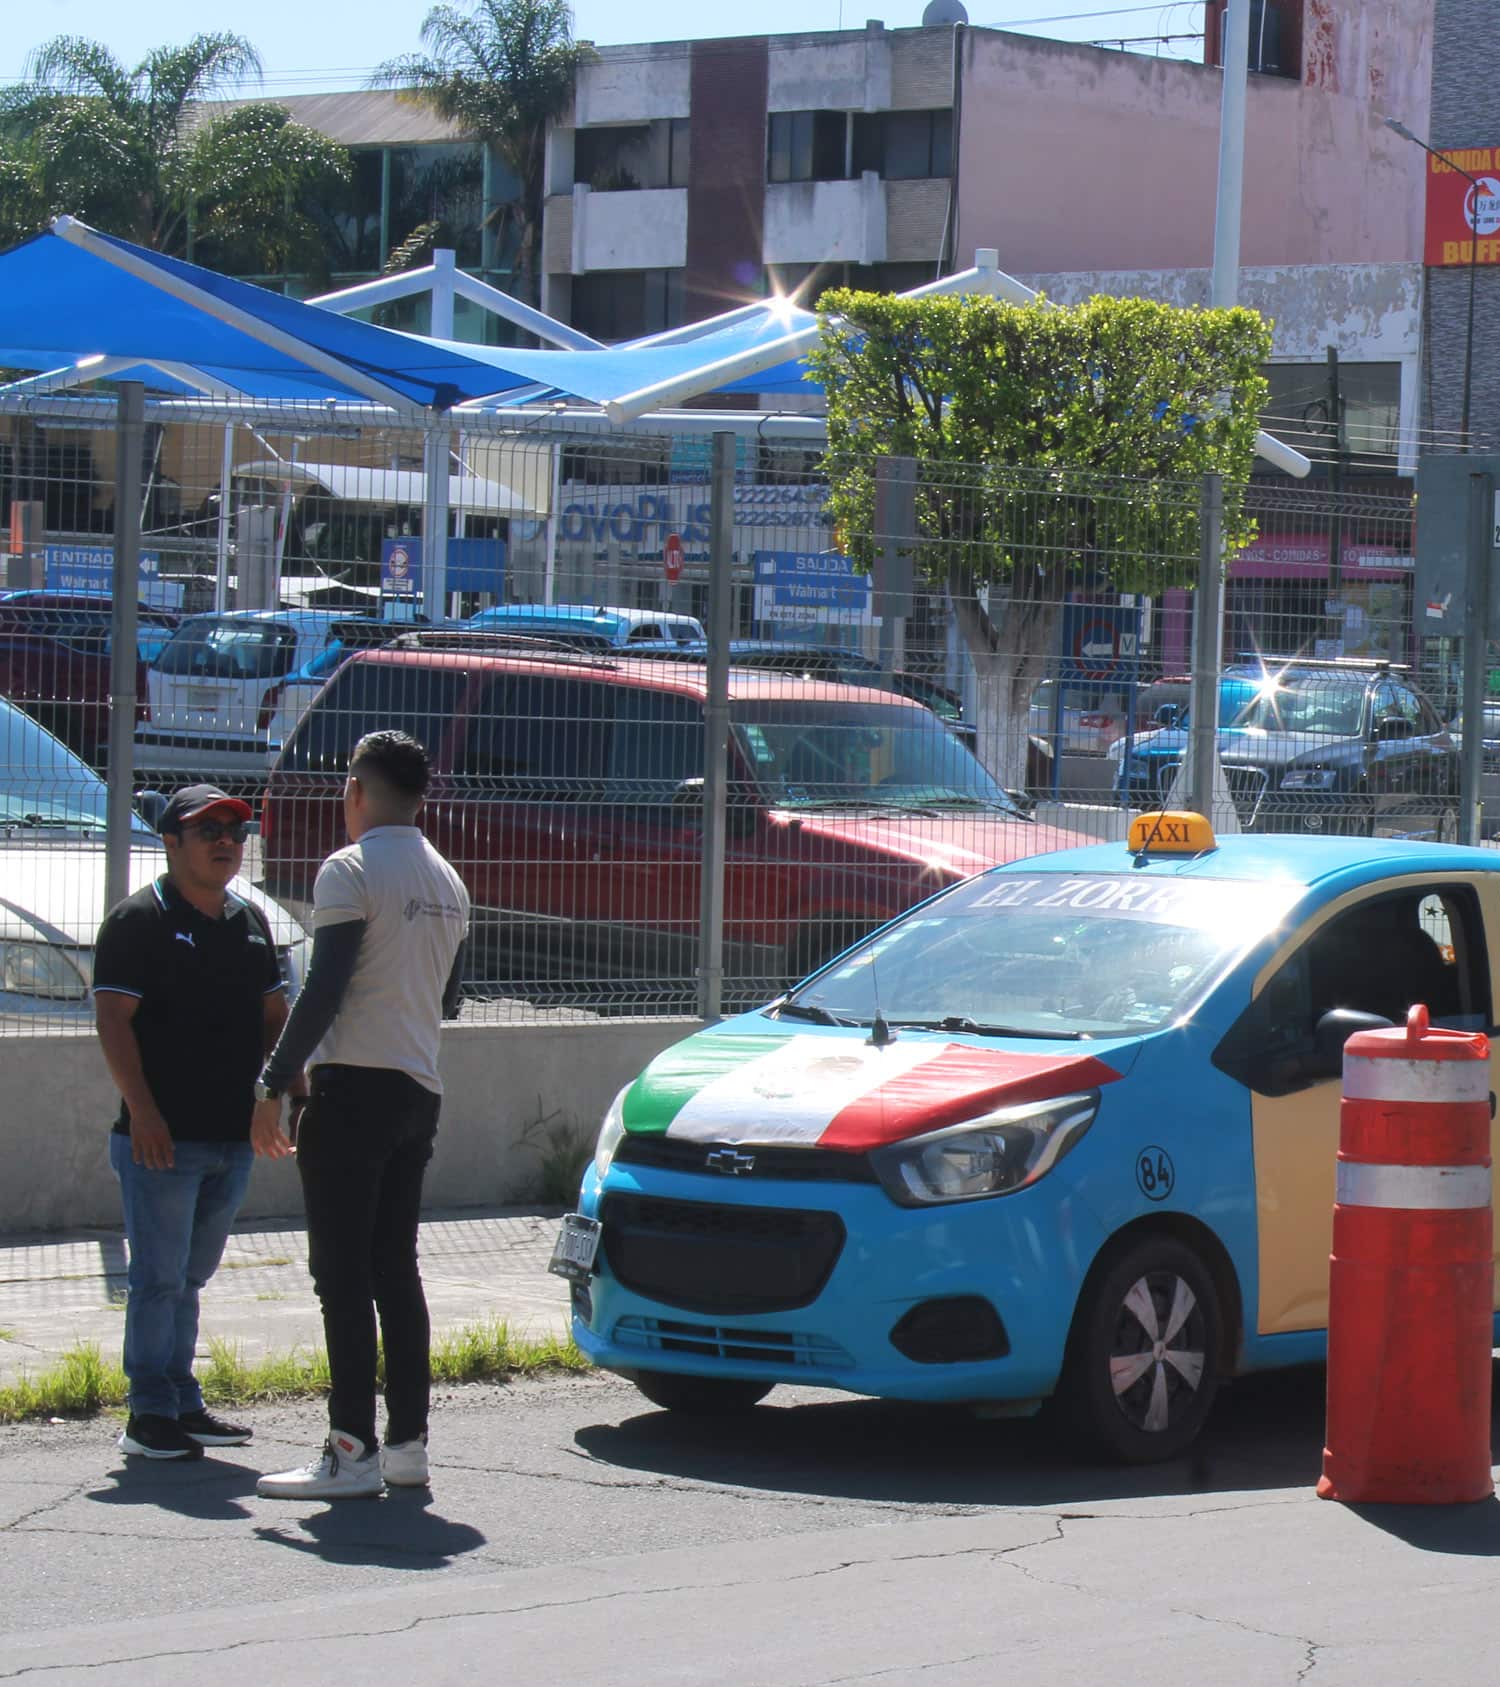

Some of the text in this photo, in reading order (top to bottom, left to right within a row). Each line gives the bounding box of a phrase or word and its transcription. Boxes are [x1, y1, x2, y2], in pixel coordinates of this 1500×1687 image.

[1431, 149, 1492, 173] COMIDA
[53, 551, 114, 563] ENTRAD
[796, 557, 850, 572] SALIDA
[1137, 823, 1190, 843] TAXI
[967, 880, 1042, 908] EL
[1140, 1153, 1170, 1191] 84
